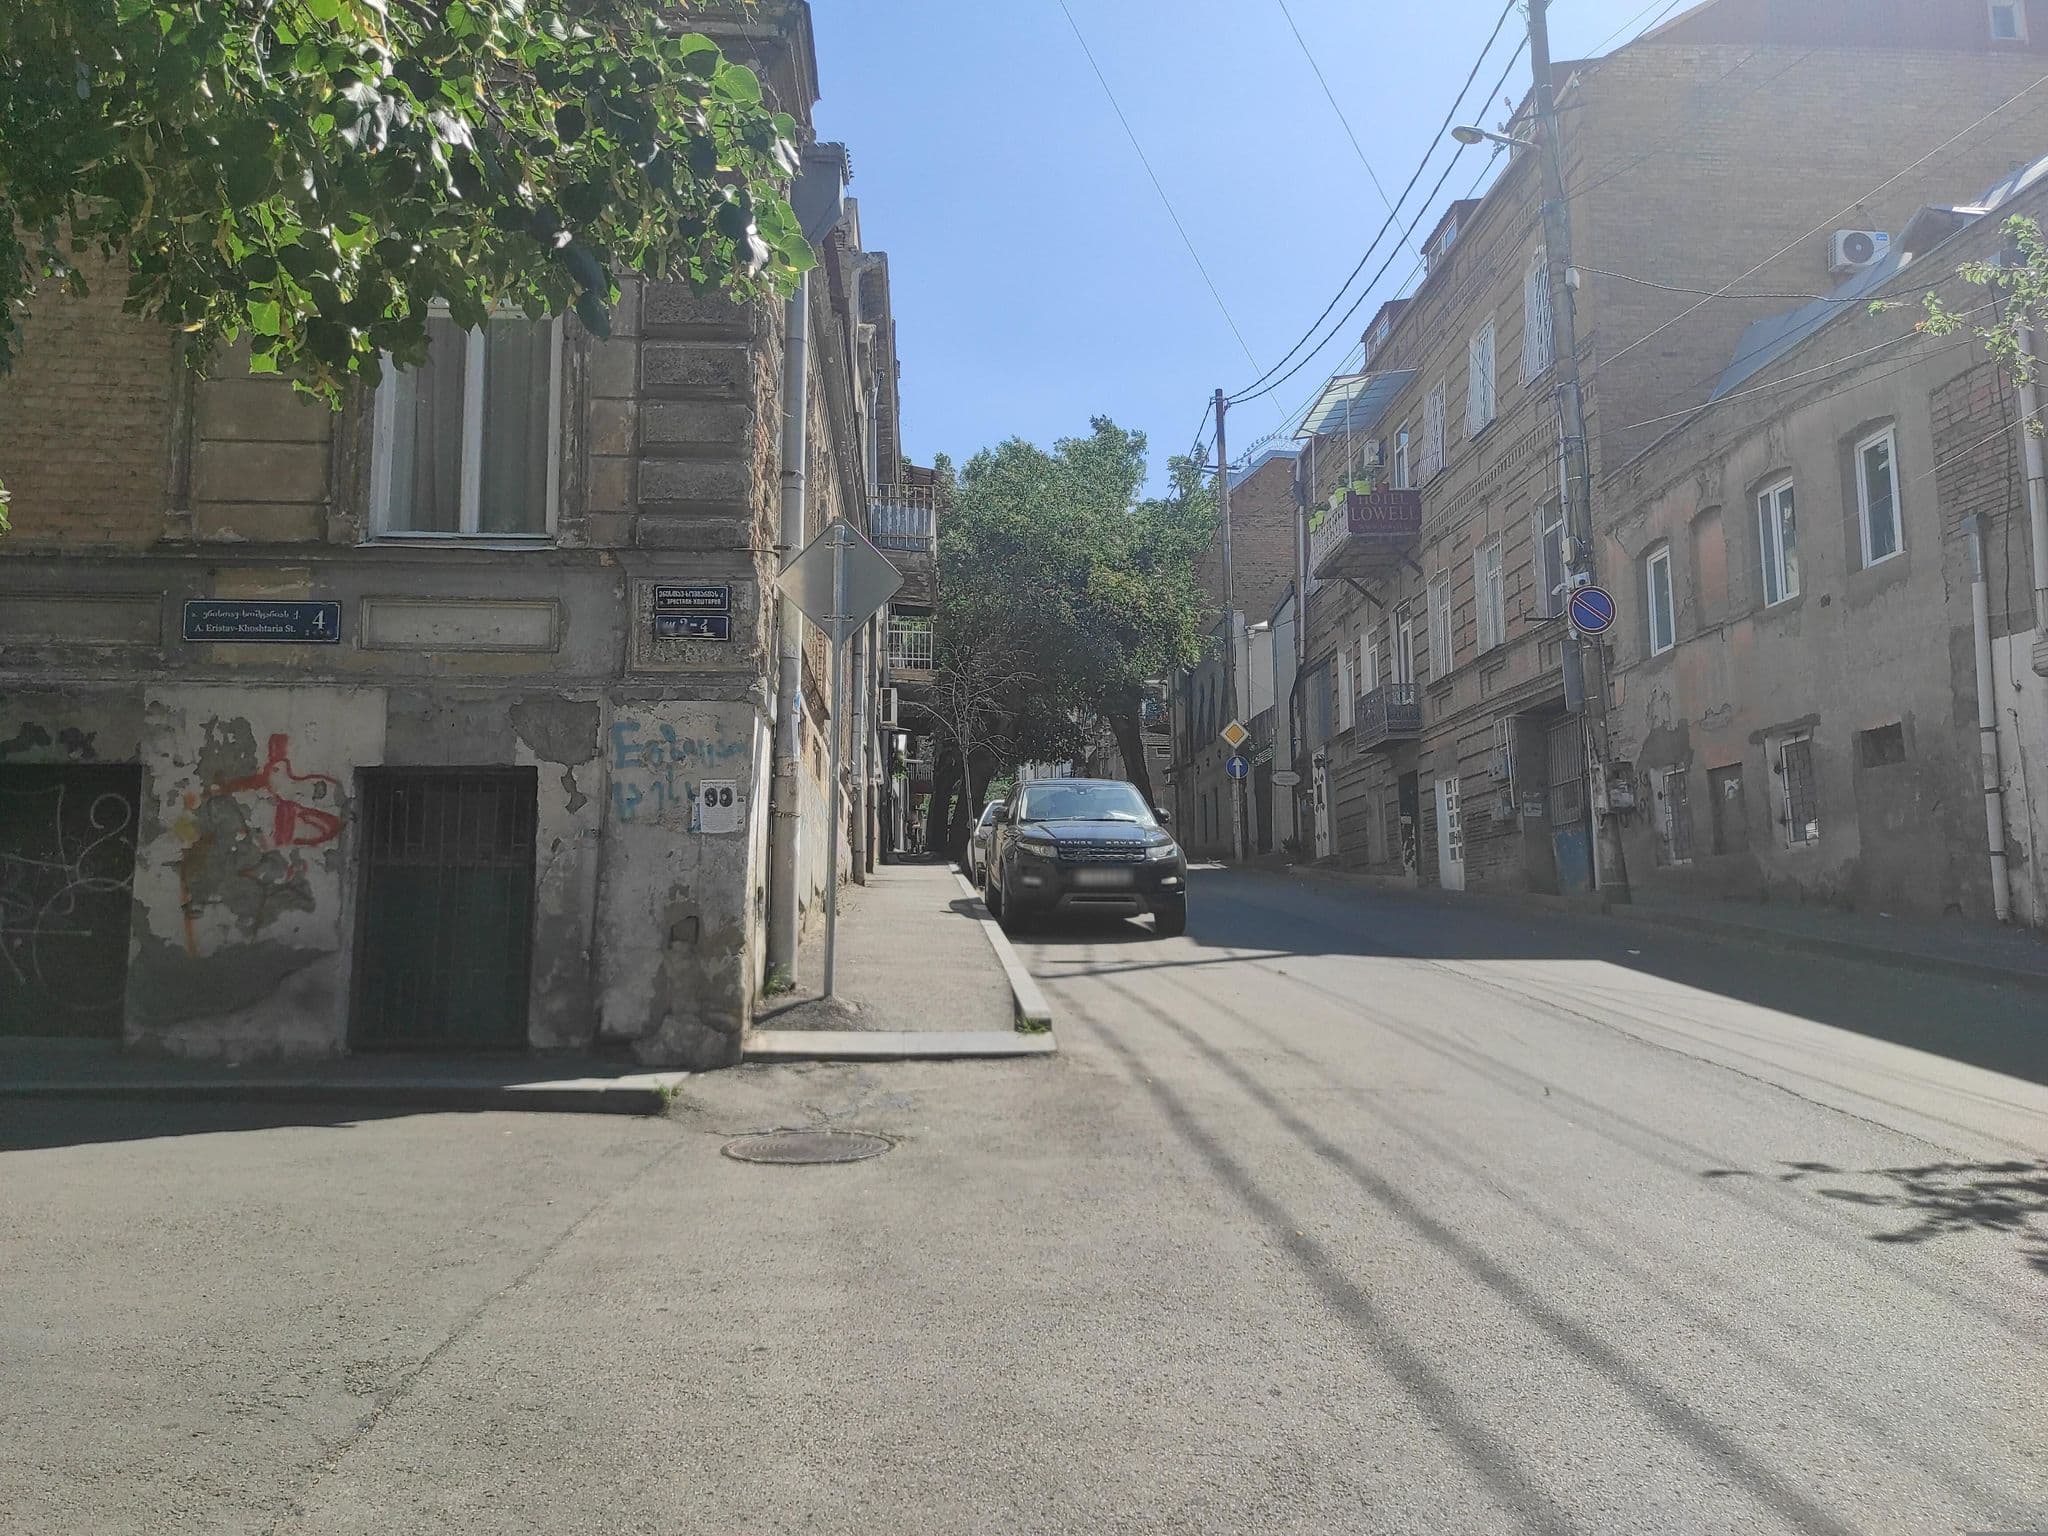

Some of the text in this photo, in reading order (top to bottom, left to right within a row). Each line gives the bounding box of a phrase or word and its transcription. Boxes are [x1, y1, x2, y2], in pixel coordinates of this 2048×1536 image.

[1359, 492, 1409, 505] HOTEL
[312, 609, 326, 629] 4
[194, 624, 296, 632] A. Eristav-Khoshtaria St.
